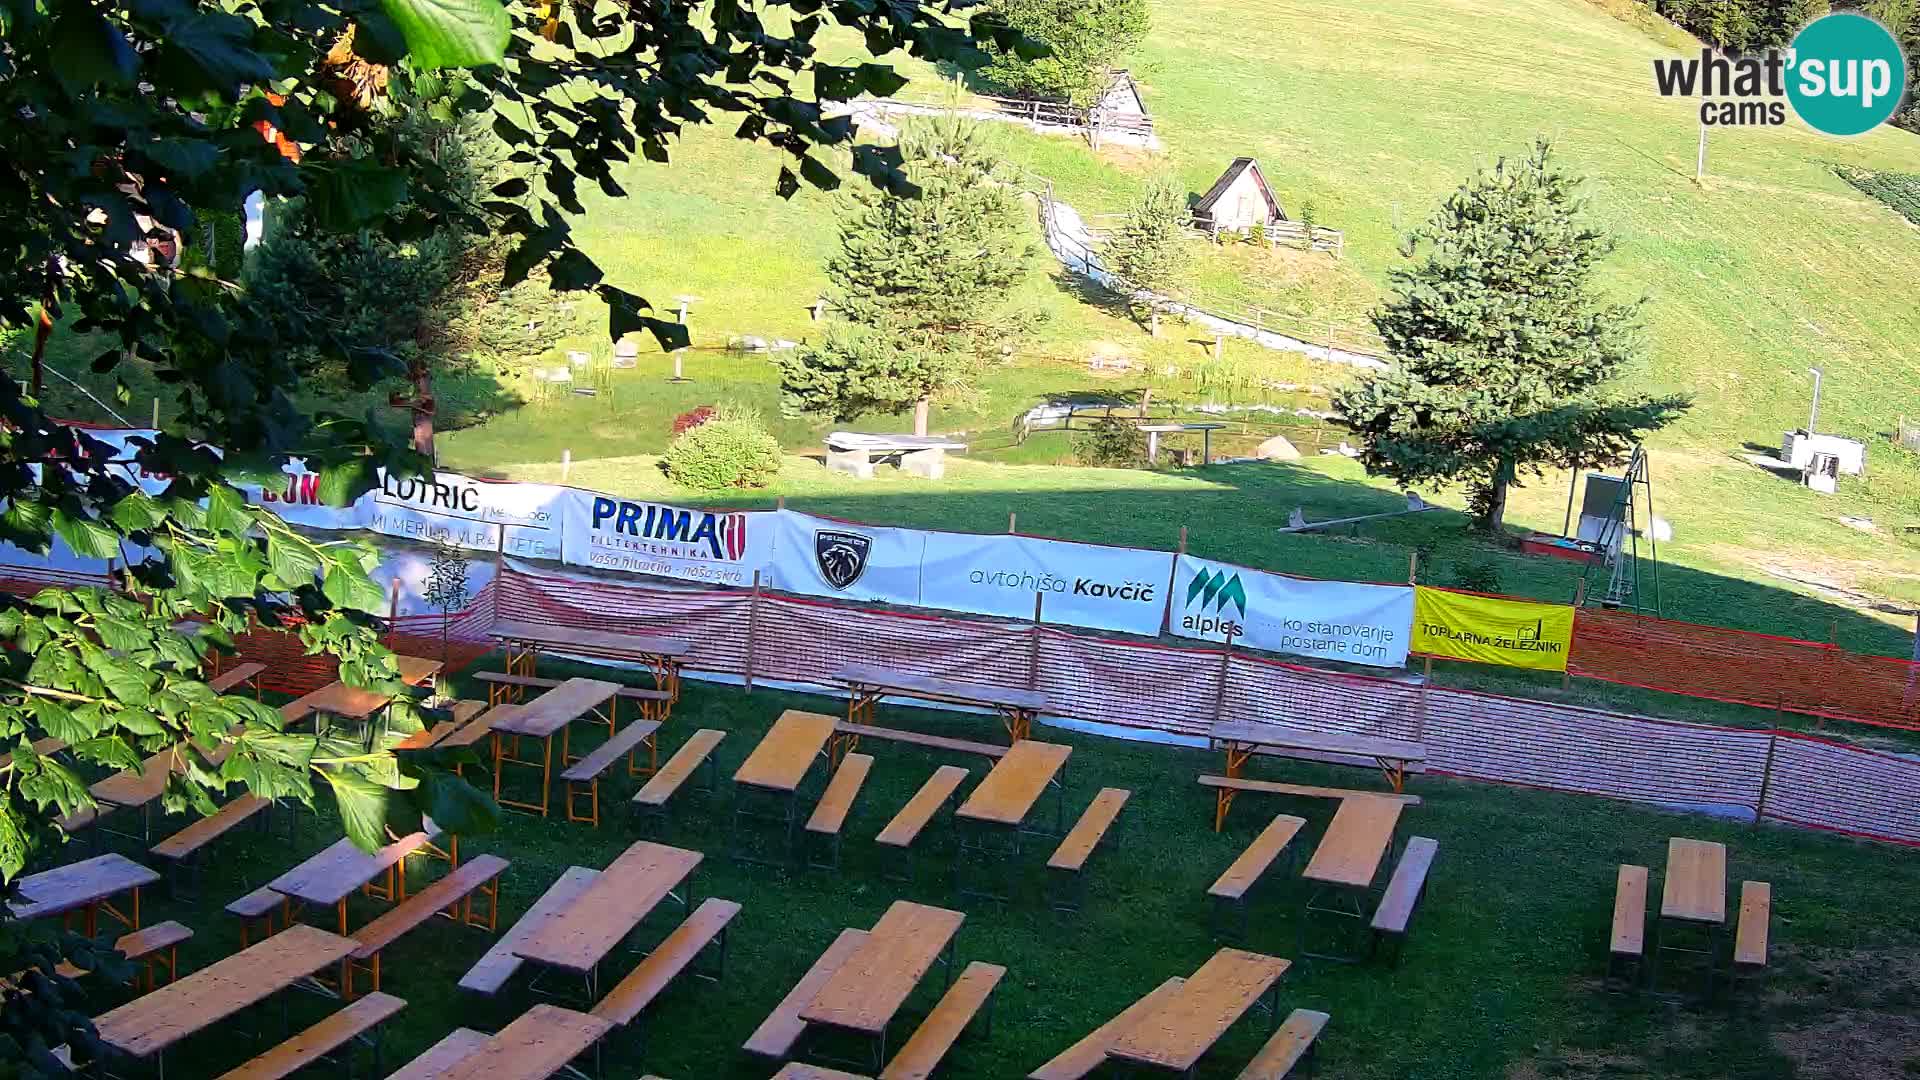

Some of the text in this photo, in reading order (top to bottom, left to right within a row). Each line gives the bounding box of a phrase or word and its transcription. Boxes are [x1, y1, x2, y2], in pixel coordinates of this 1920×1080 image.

[384, 474, 479, 511] LOTRIČ
[371, 513, 387, 529] MI
[592, 496, 723, 559] PRIMA
[969, 567, 1155, 602] avtohiša Kavčič
[1182, 614, 1244, 636] alples
[1307, 621, 1394, 643] stanovanje
[1422, 623, 1561, 653] TOPLARNA ŽELEZNIKI
[1281, 635, 1387, 658] postane dom
